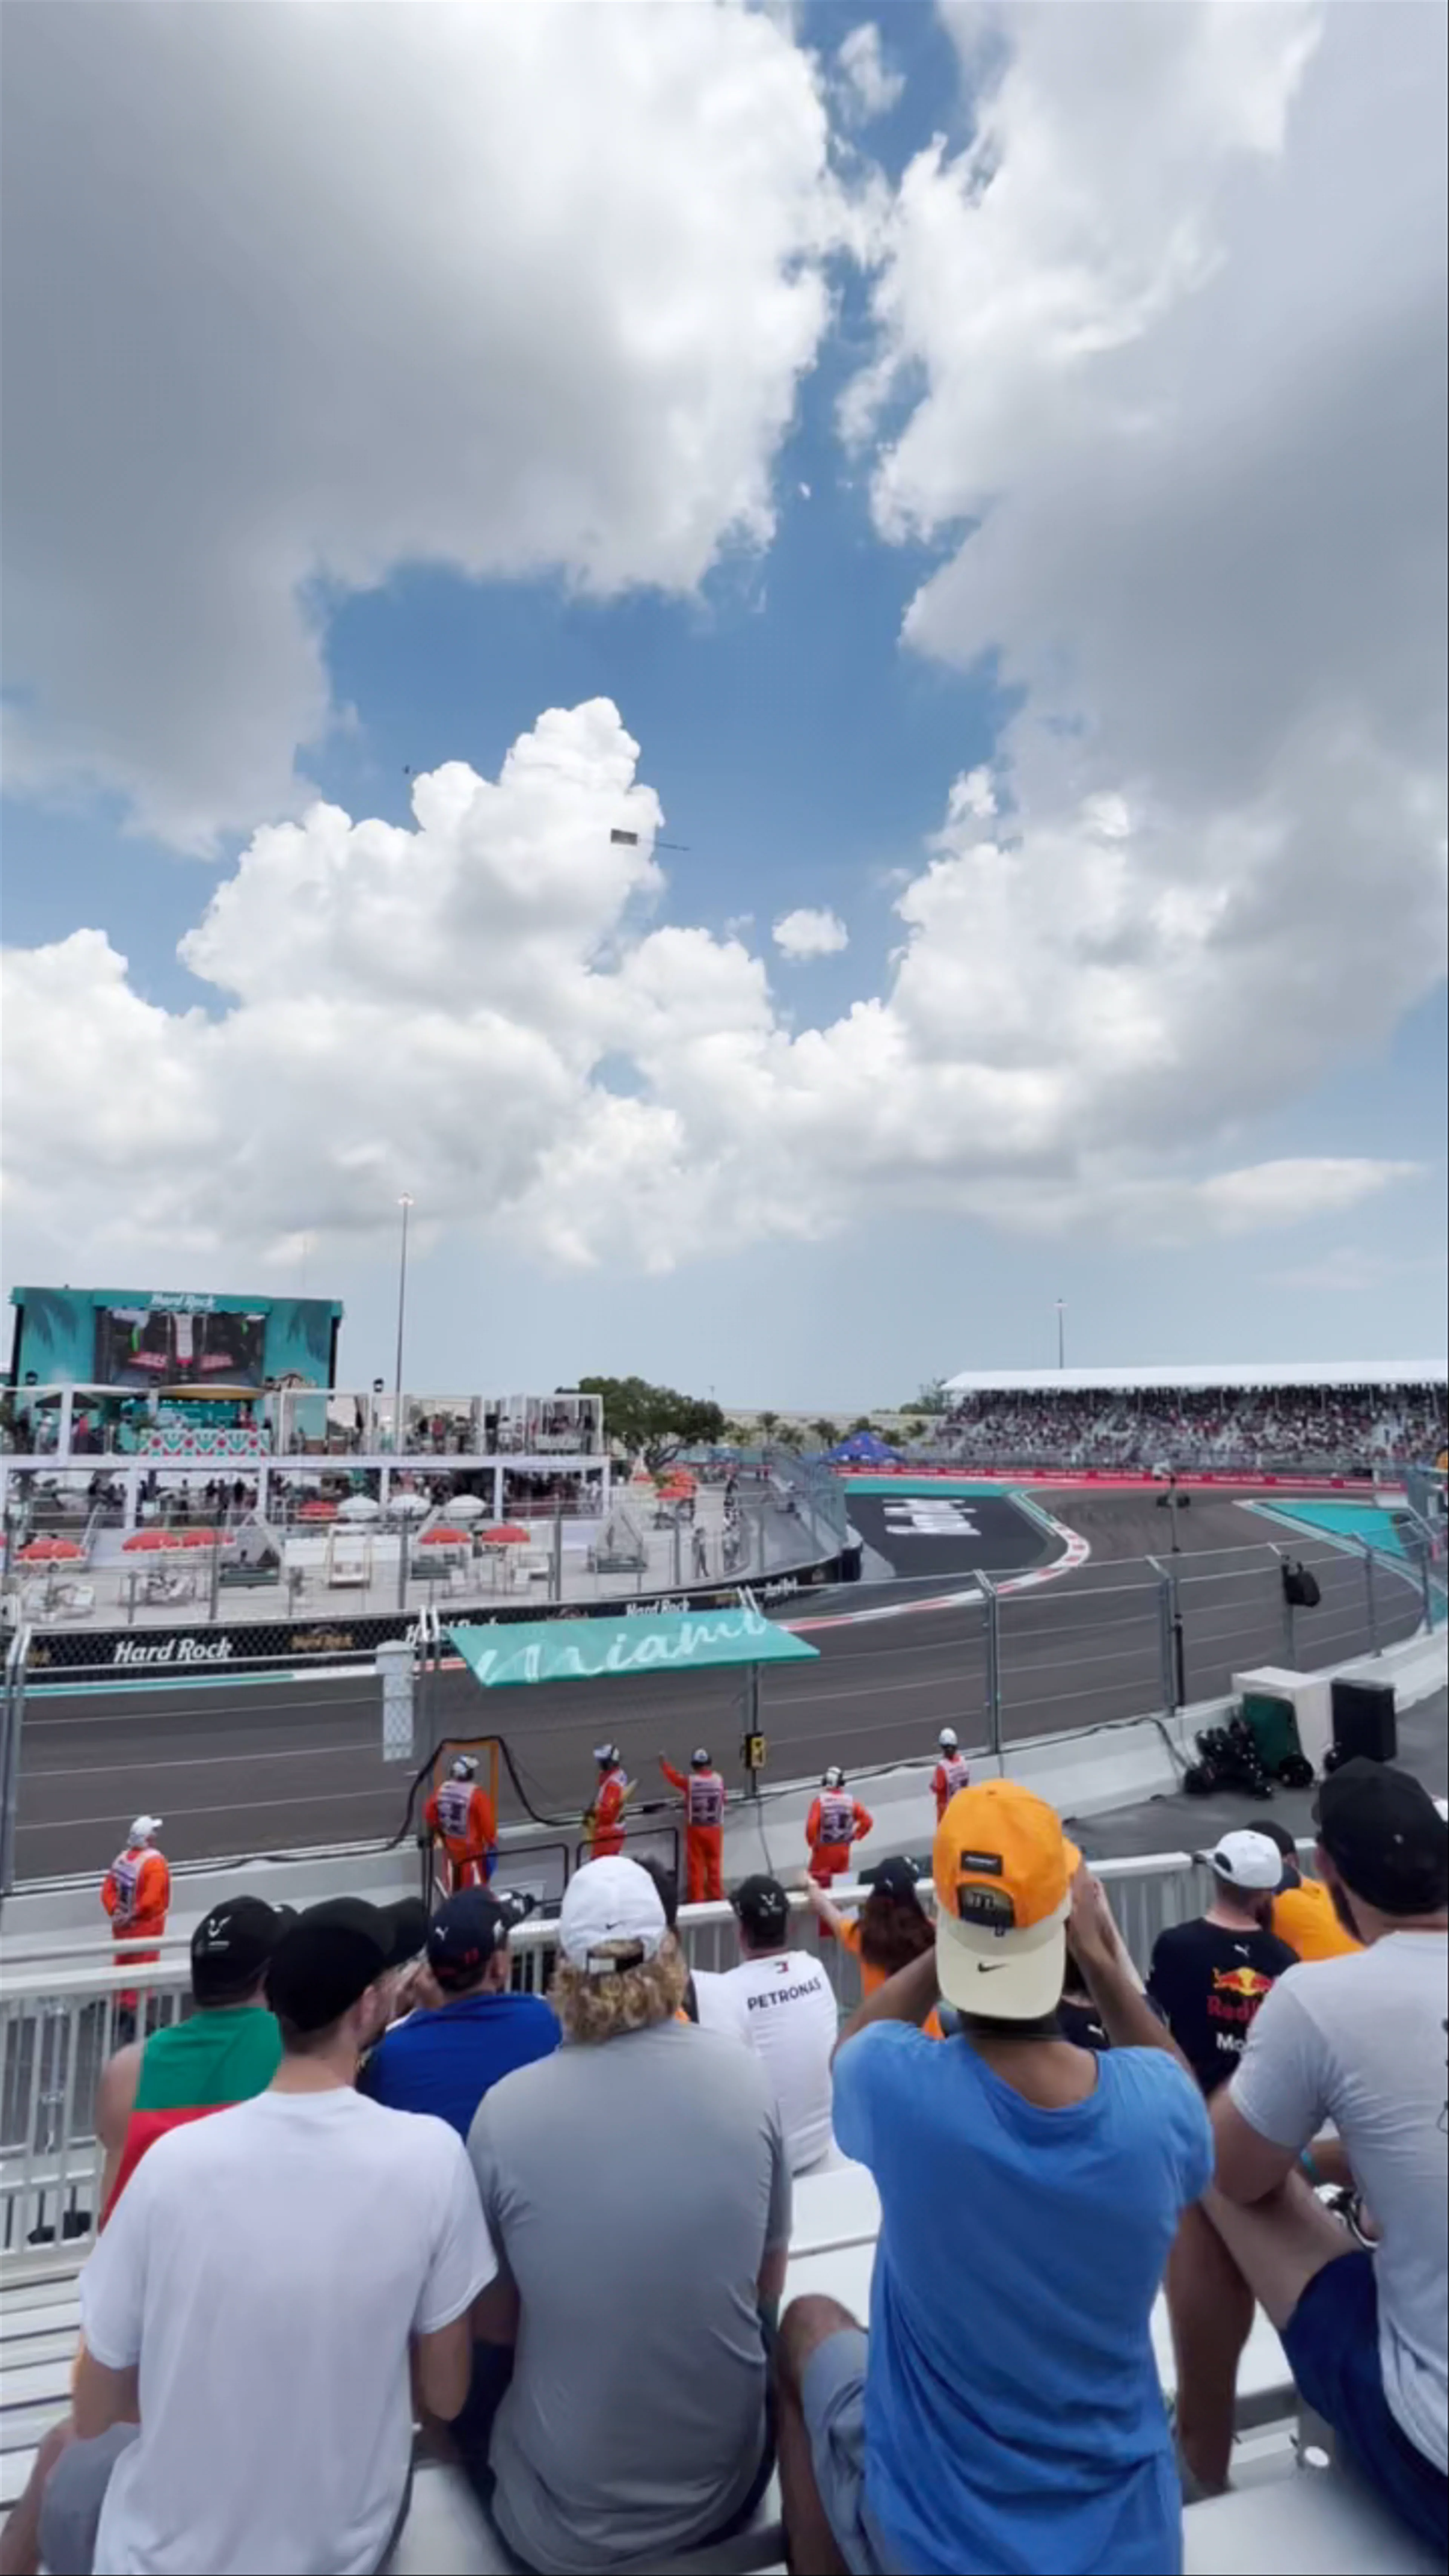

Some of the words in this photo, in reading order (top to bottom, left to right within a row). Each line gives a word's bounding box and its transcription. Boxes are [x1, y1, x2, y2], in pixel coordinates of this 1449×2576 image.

[115, 1640, 175, 1661] Hard
[178, 1637, 232, 1659] Rock
[748, 1976, 821, 2011] PETRONAS
[1207, 1995, 1249, 2020] Red
[1216, 2032, 1246, 2050] Mo
